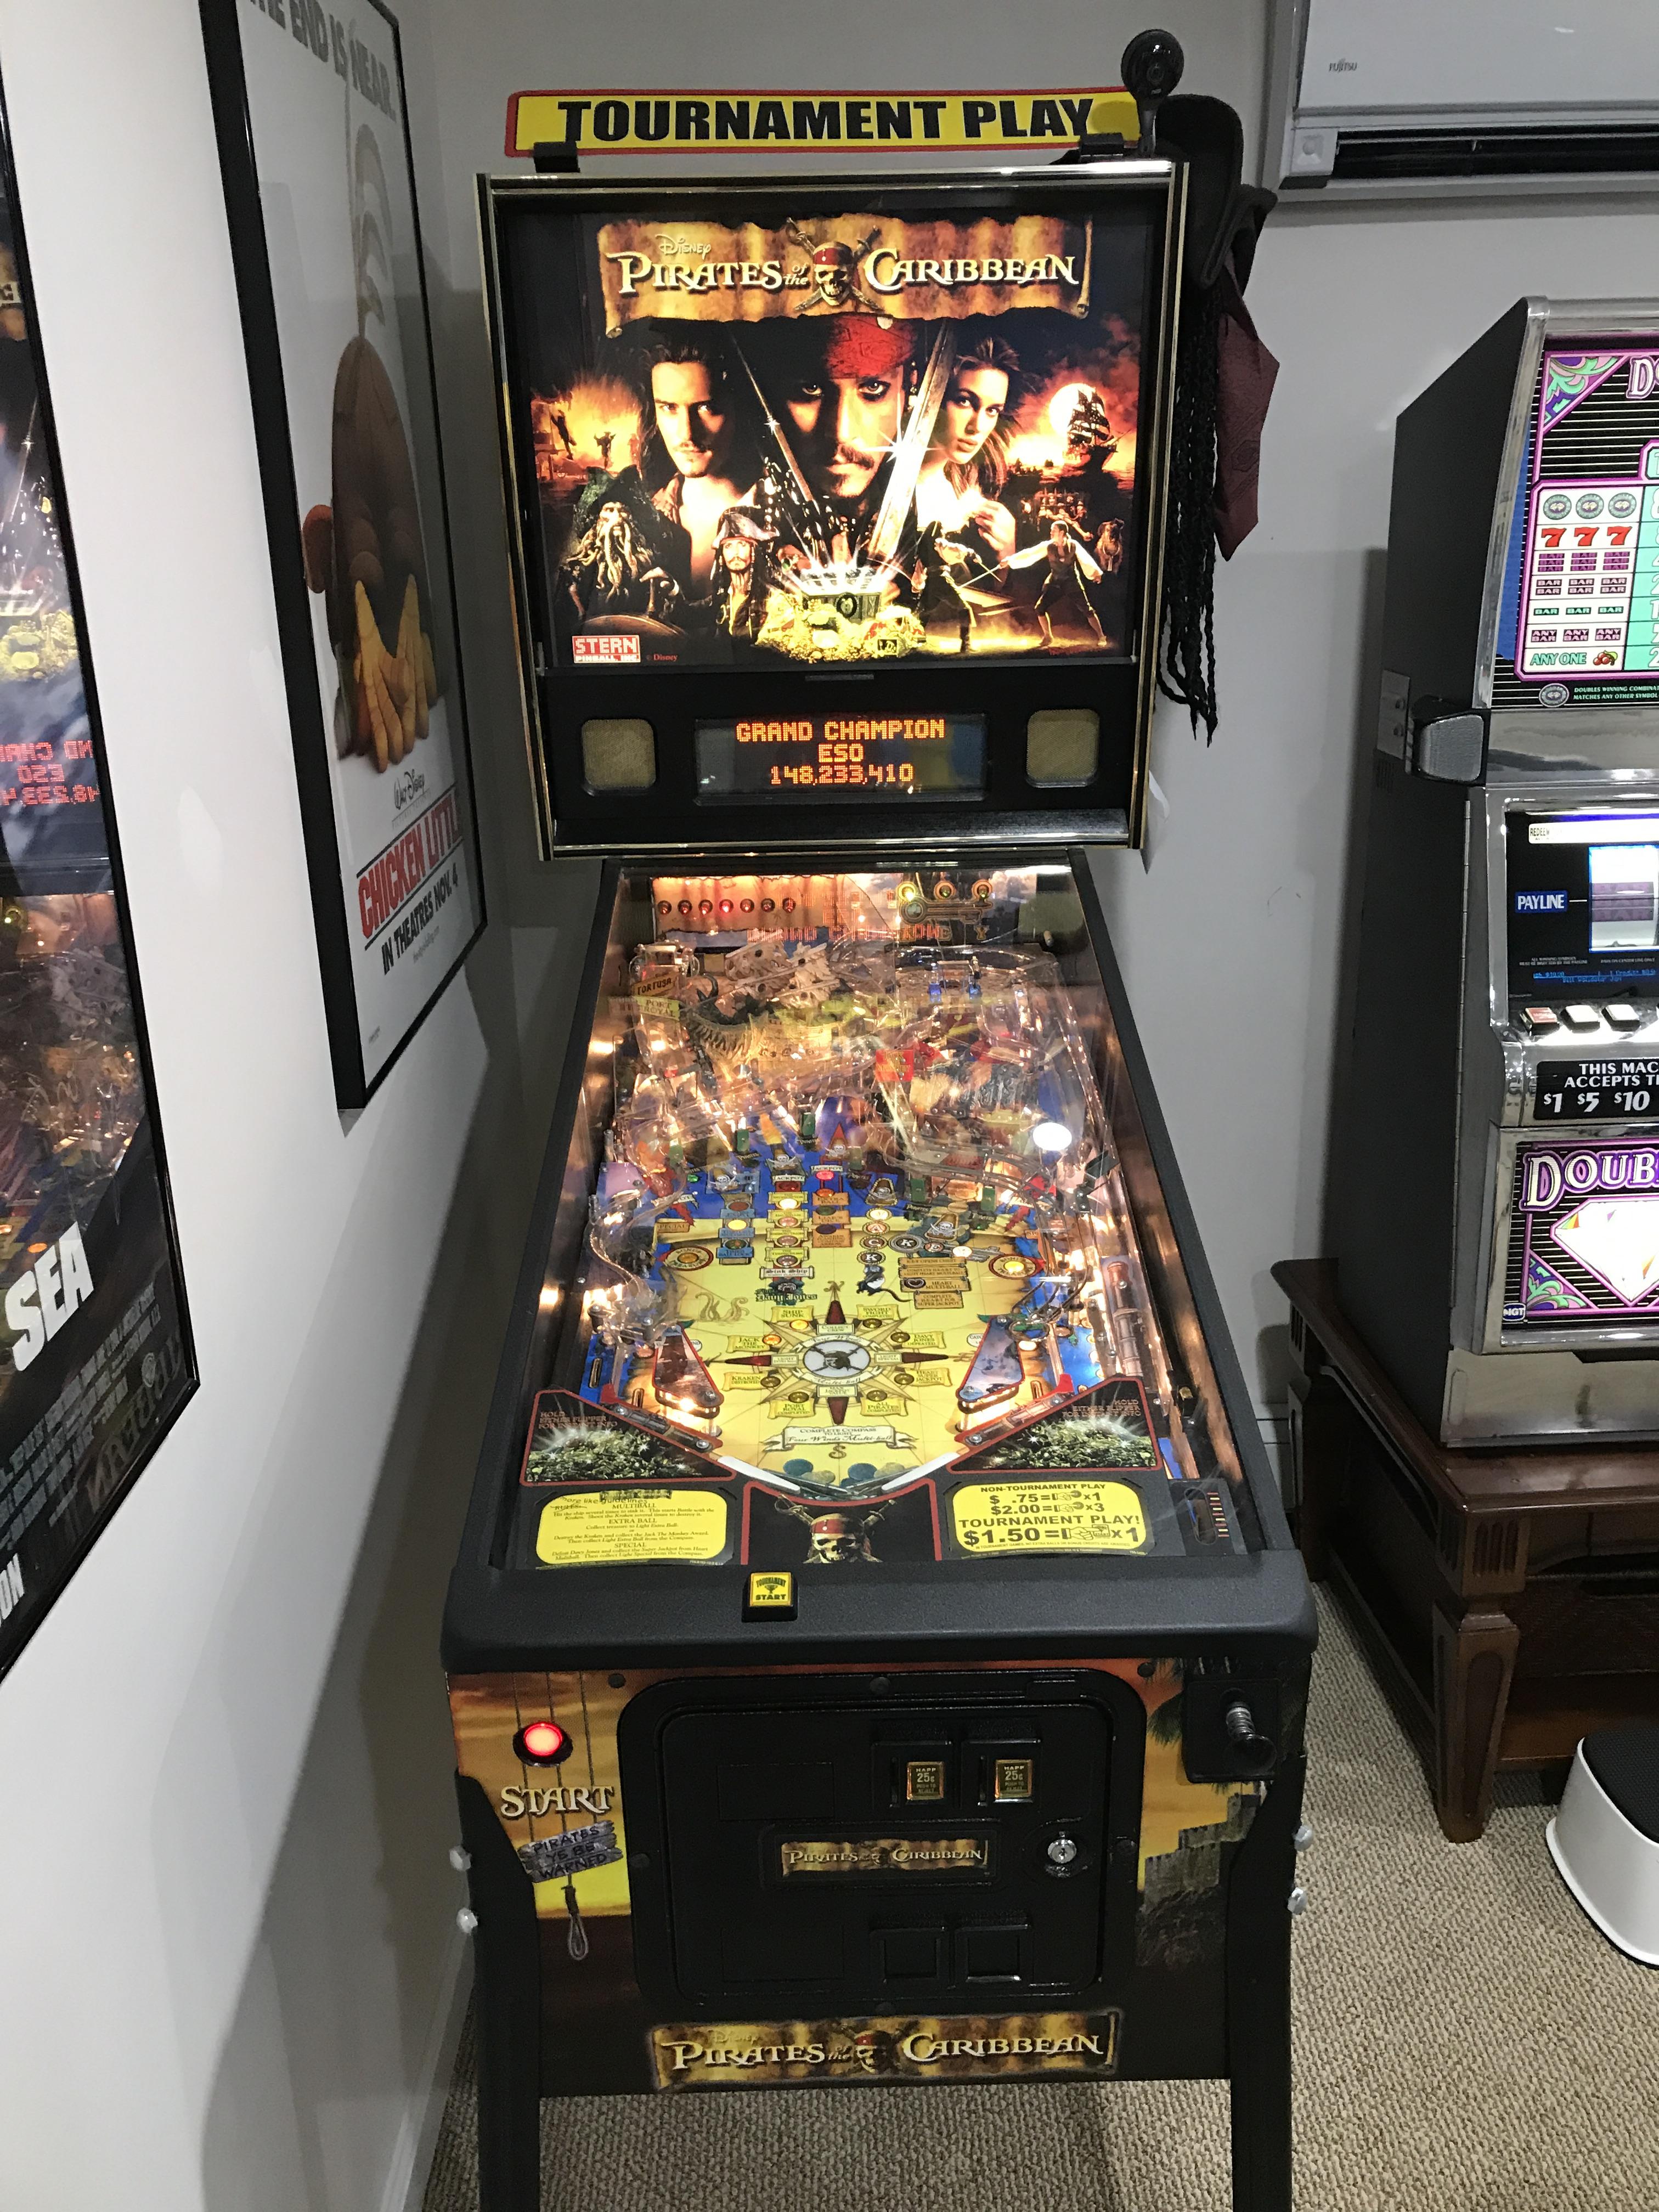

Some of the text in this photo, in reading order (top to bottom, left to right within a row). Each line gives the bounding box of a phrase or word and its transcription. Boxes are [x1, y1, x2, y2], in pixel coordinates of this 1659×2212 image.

[289, 0, 328, 63] END
[329, 13, 348, 81] IS
[1329, 58, 1357, 72] FUJITSU
[558, 98, 1093, 142] TOURNAMENT PLAY
[655, 234, 711, 259] Disney
[606, 248, 1079, 294] PIRATES of the CARIBBEAN
[1541, 526, 1633, 548] 7 7 7
[575, 637, 637, 653] STERN
[1530, 653, 1587, 666] ANY ONE
[736, 719, 945, 742] GRAND CHAMPION
[818, 743, 865, 763] ESO
[771, 763, 914, 786] 148,233,410
[358, 826, 426, 939] CHICKEN
[1517, 894, 1565, 910] PAYLINE
[381, 936, 393, 975] IN
[394, 891, 433, 958] THEATRES
[644, 1006, 676, 1017] ROYAL
[646, 999, 672, 1008] PORT
[1579, 1063, 1617, 1075] THIS
[1564, 1074, 1640, 1088] ACCEPTS
[1544, 1091, 1650, 1113] $1 $5 $10
[1524, 1153, 1659, 1207] DOUB
[5, 1221, 94, 1372] SEA
[1510, 1307, 1525, 1316] IGT
[981, 1484, 1077, 1492] NON-TOURNAMENT
[958, 1515, 1140, 1528] TOURNAMENT PLAY!
[755, 1577, 787, 1588] TOURNAMENT
[500, 1785, 614, 1817] START
[533, 1825, 600, 1854] PIRATES
[548, 1841, 595, 1863] YE BE
[785, 1849, 983, 1864] PIRATES CARIBBEAN
[539, 1854, 607, 1881] WARNED
[661, 2032, 1104, 2070] PIRATES CARIBBEAN
